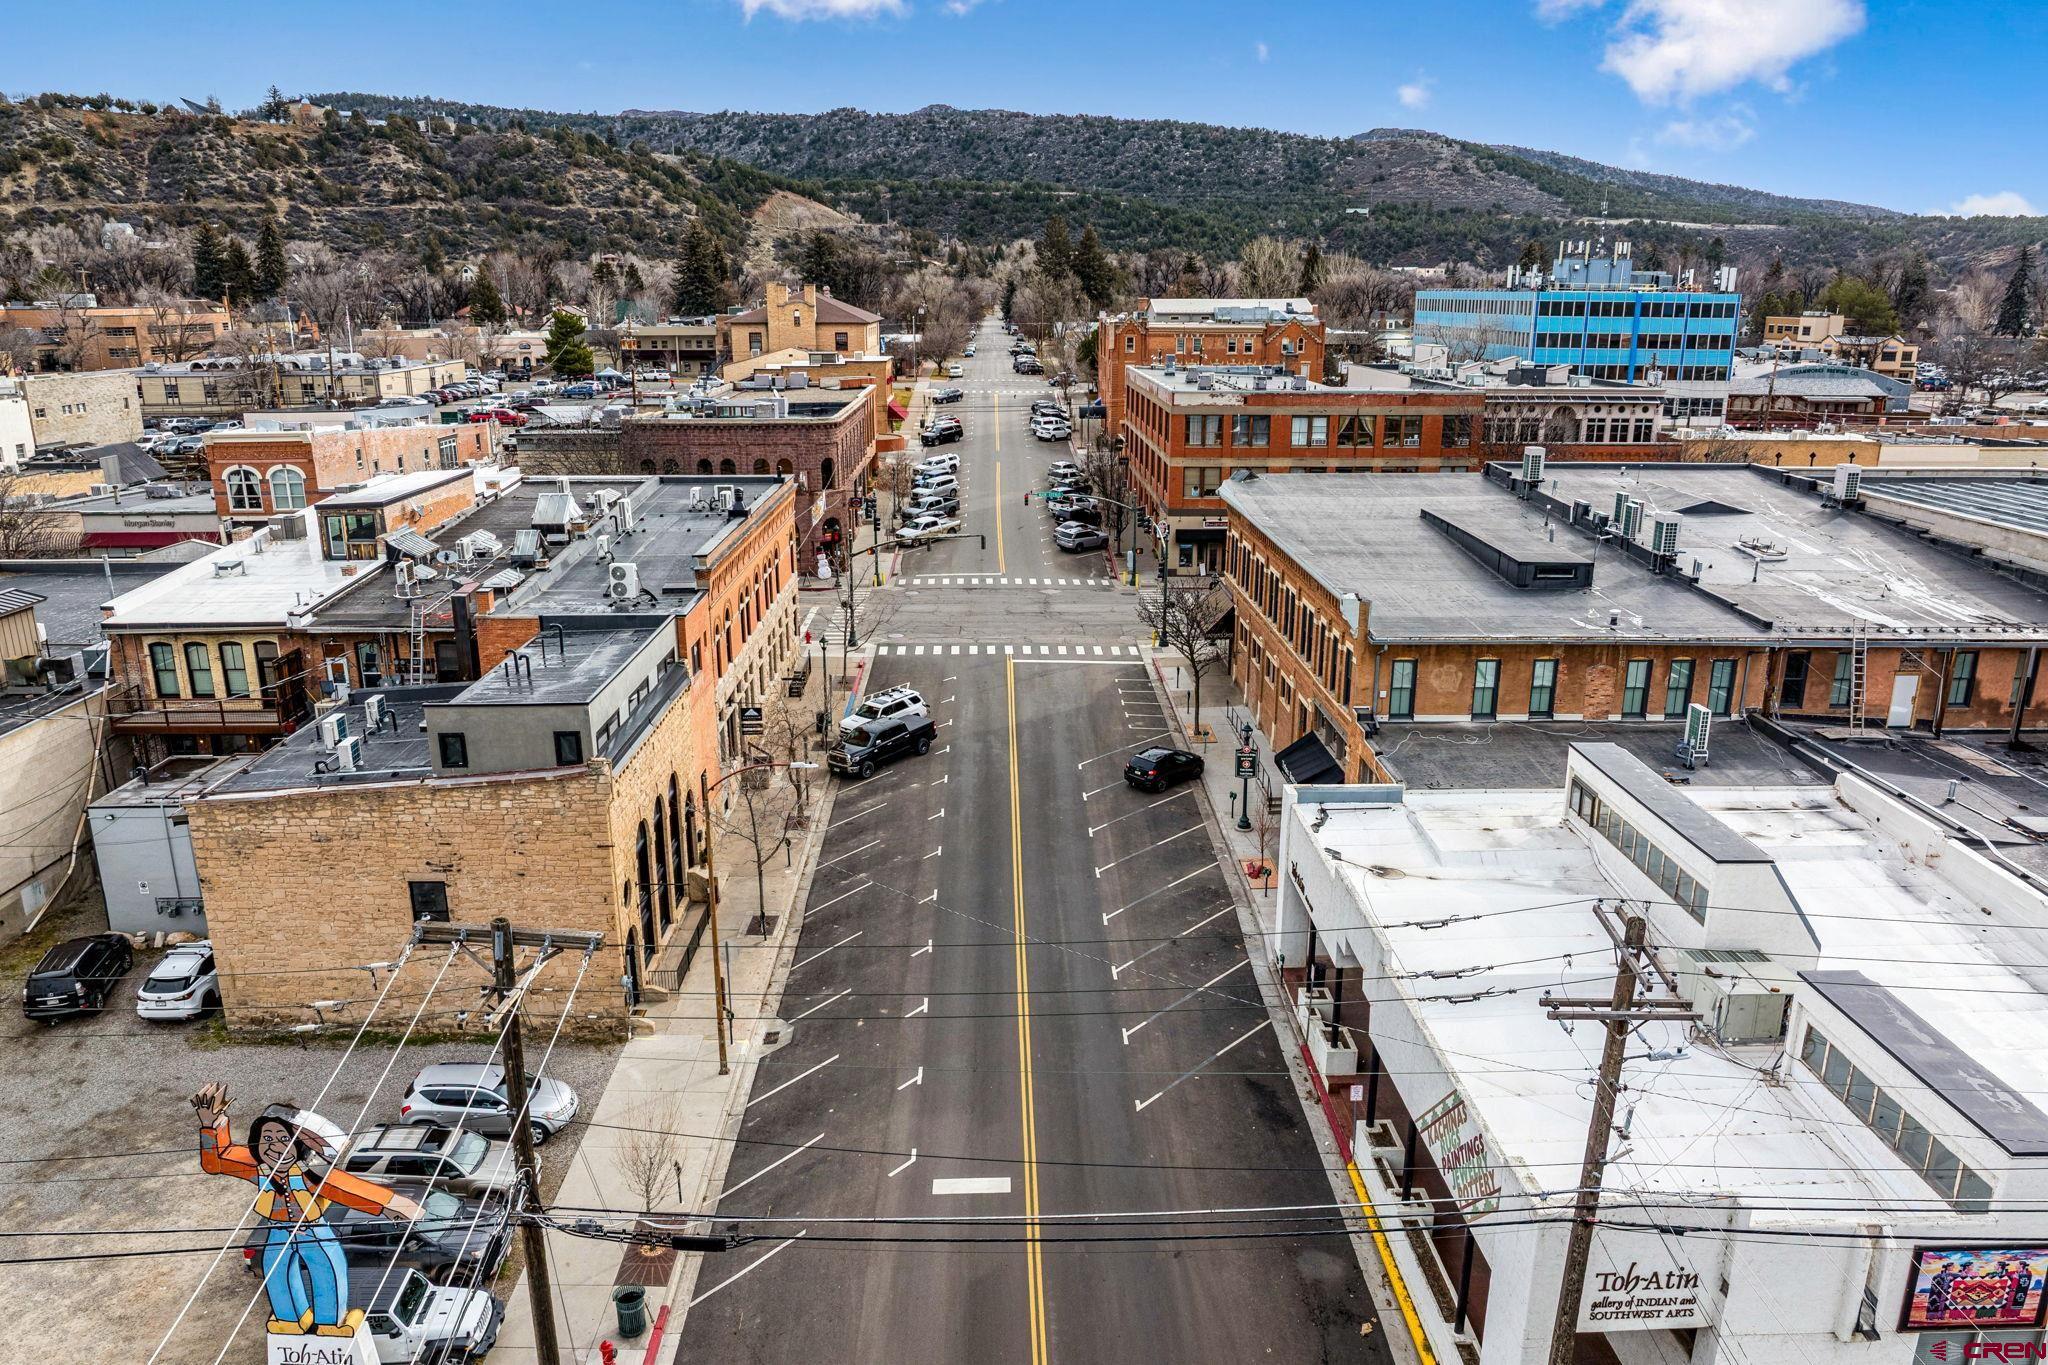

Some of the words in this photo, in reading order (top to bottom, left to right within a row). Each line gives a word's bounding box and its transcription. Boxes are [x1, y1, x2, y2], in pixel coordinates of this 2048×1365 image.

[1427, 1103, 1467, 1147] KACHINAS
[1440, 1128, 1461, 1156] RUGS
[1442, 1133, 1485, 1176] PAINTINGS
[1452, 1151, 1488, 1190] JEWELRY
[1458, 1169, 1495, 1203] POTTERY
[1589, 1309, 1664, 1320] SOUTHWEST
[1666, 1308, 1694, 1318] ARTS
[1591, 1296, 1623, 1311] gallery
[1625, 1295, 1635, 1309] of
[1636, 1297, 1678, 1307] INDIAN
[1680, 1295, 1697, 1305] and
